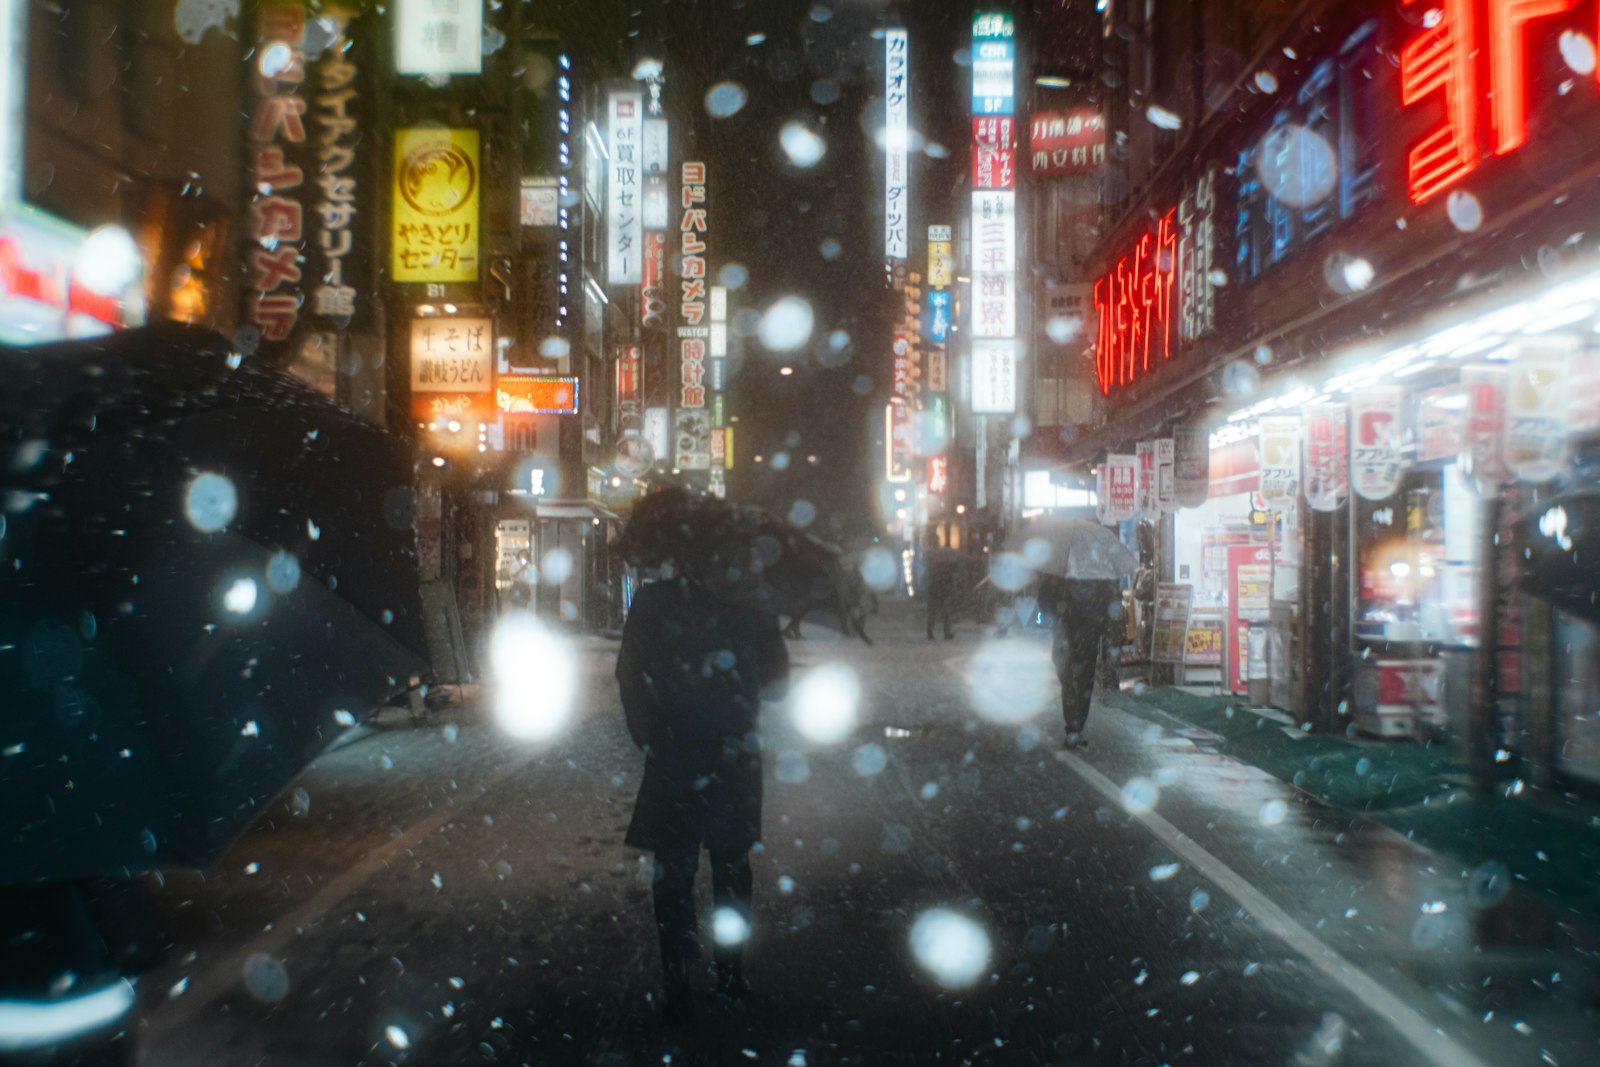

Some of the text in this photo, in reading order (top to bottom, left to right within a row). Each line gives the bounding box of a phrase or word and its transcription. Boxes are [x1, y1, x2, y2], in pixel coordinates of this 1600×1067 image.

[888, 38, 905, 106] カラオケ
[616, 145, 637, 274] 買取センター
[888, 186, 905, 252] ダーツバー
[398, 223, 472, 245] やきとり
[681, 161, 707, 325] ヨドバシカメラ
[400, 250, 474, 270] センター
[426, 284, 445, 298] B1
[677, 326, 708, 337] WATCH
